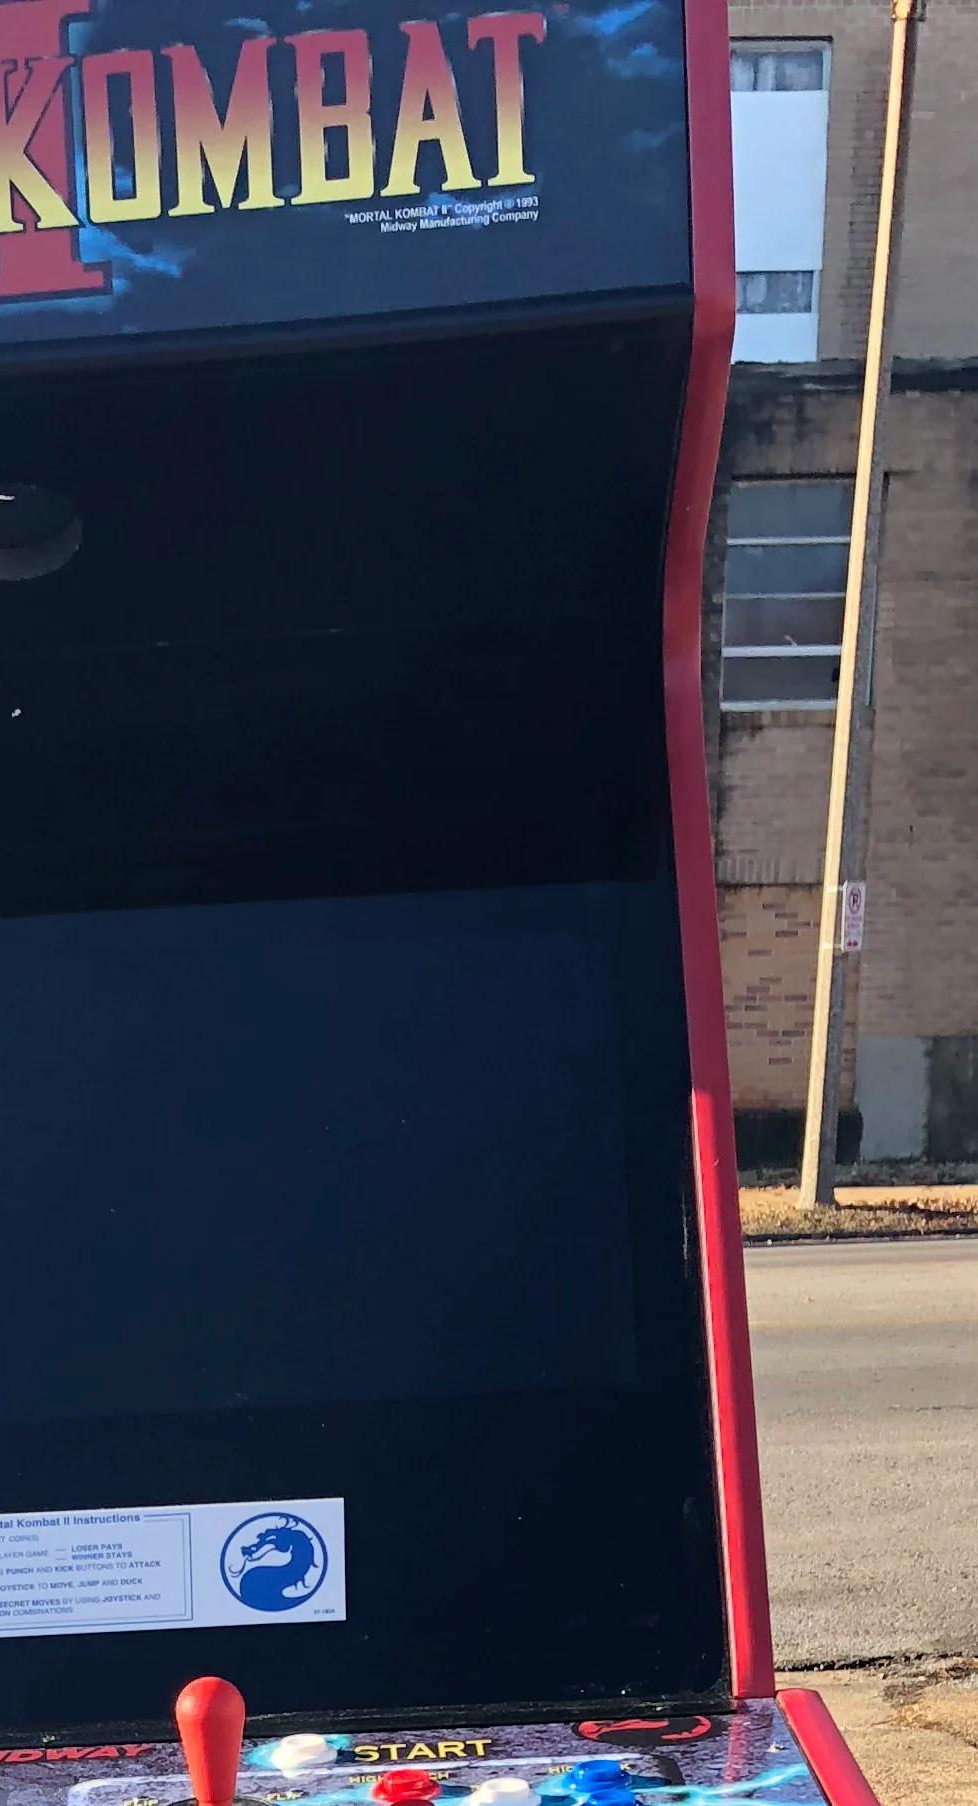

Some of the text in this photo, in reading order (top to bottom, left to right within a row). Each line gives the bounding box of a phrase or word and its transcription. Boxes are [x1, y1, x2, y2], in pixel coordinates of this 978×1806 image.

[395, 206, 439, 220] KOMBAT
[455, 201, 502, 216] Copyright
[517, 196, 539, 208] 1993
[380, 210, 539, 233] Midway Manufacturing Company
[17, 1517, 60, 1528] Kombat
[73, 1513, 141, 1525] Instructions
[25, 1549, 49, 1558] GAME
[71, 1543, 123, 1552] LOSER PAYS
[71, 1551, 133, 1561] WINNER STAYS
[6, 1566, 35, 1575] PUNCH
[54, 1564, 74, 1573] KICK
[75, 1562, 114, 1572] BUTTONS
[128, 1560, 161, 1569] ATTACK
[37, 1582, 48, 1590] TO
[77, 1580, 100, 1588] JUMP
[101, 1578, 119, 1586] AND
[120, 1577, 143, 1585] DUCK
[32, 1598, 61, 1607] MOVES
[62, 1597, 73, 1605] BY
[75, 1596, 101, 1604] USING
[102, 1594, 142, 1603] JOYSTICK
[143, 1593, 161, 1601] AND
[353, 1739, 492, 1762] START
[549, 1765, 574, 1774] HIG
